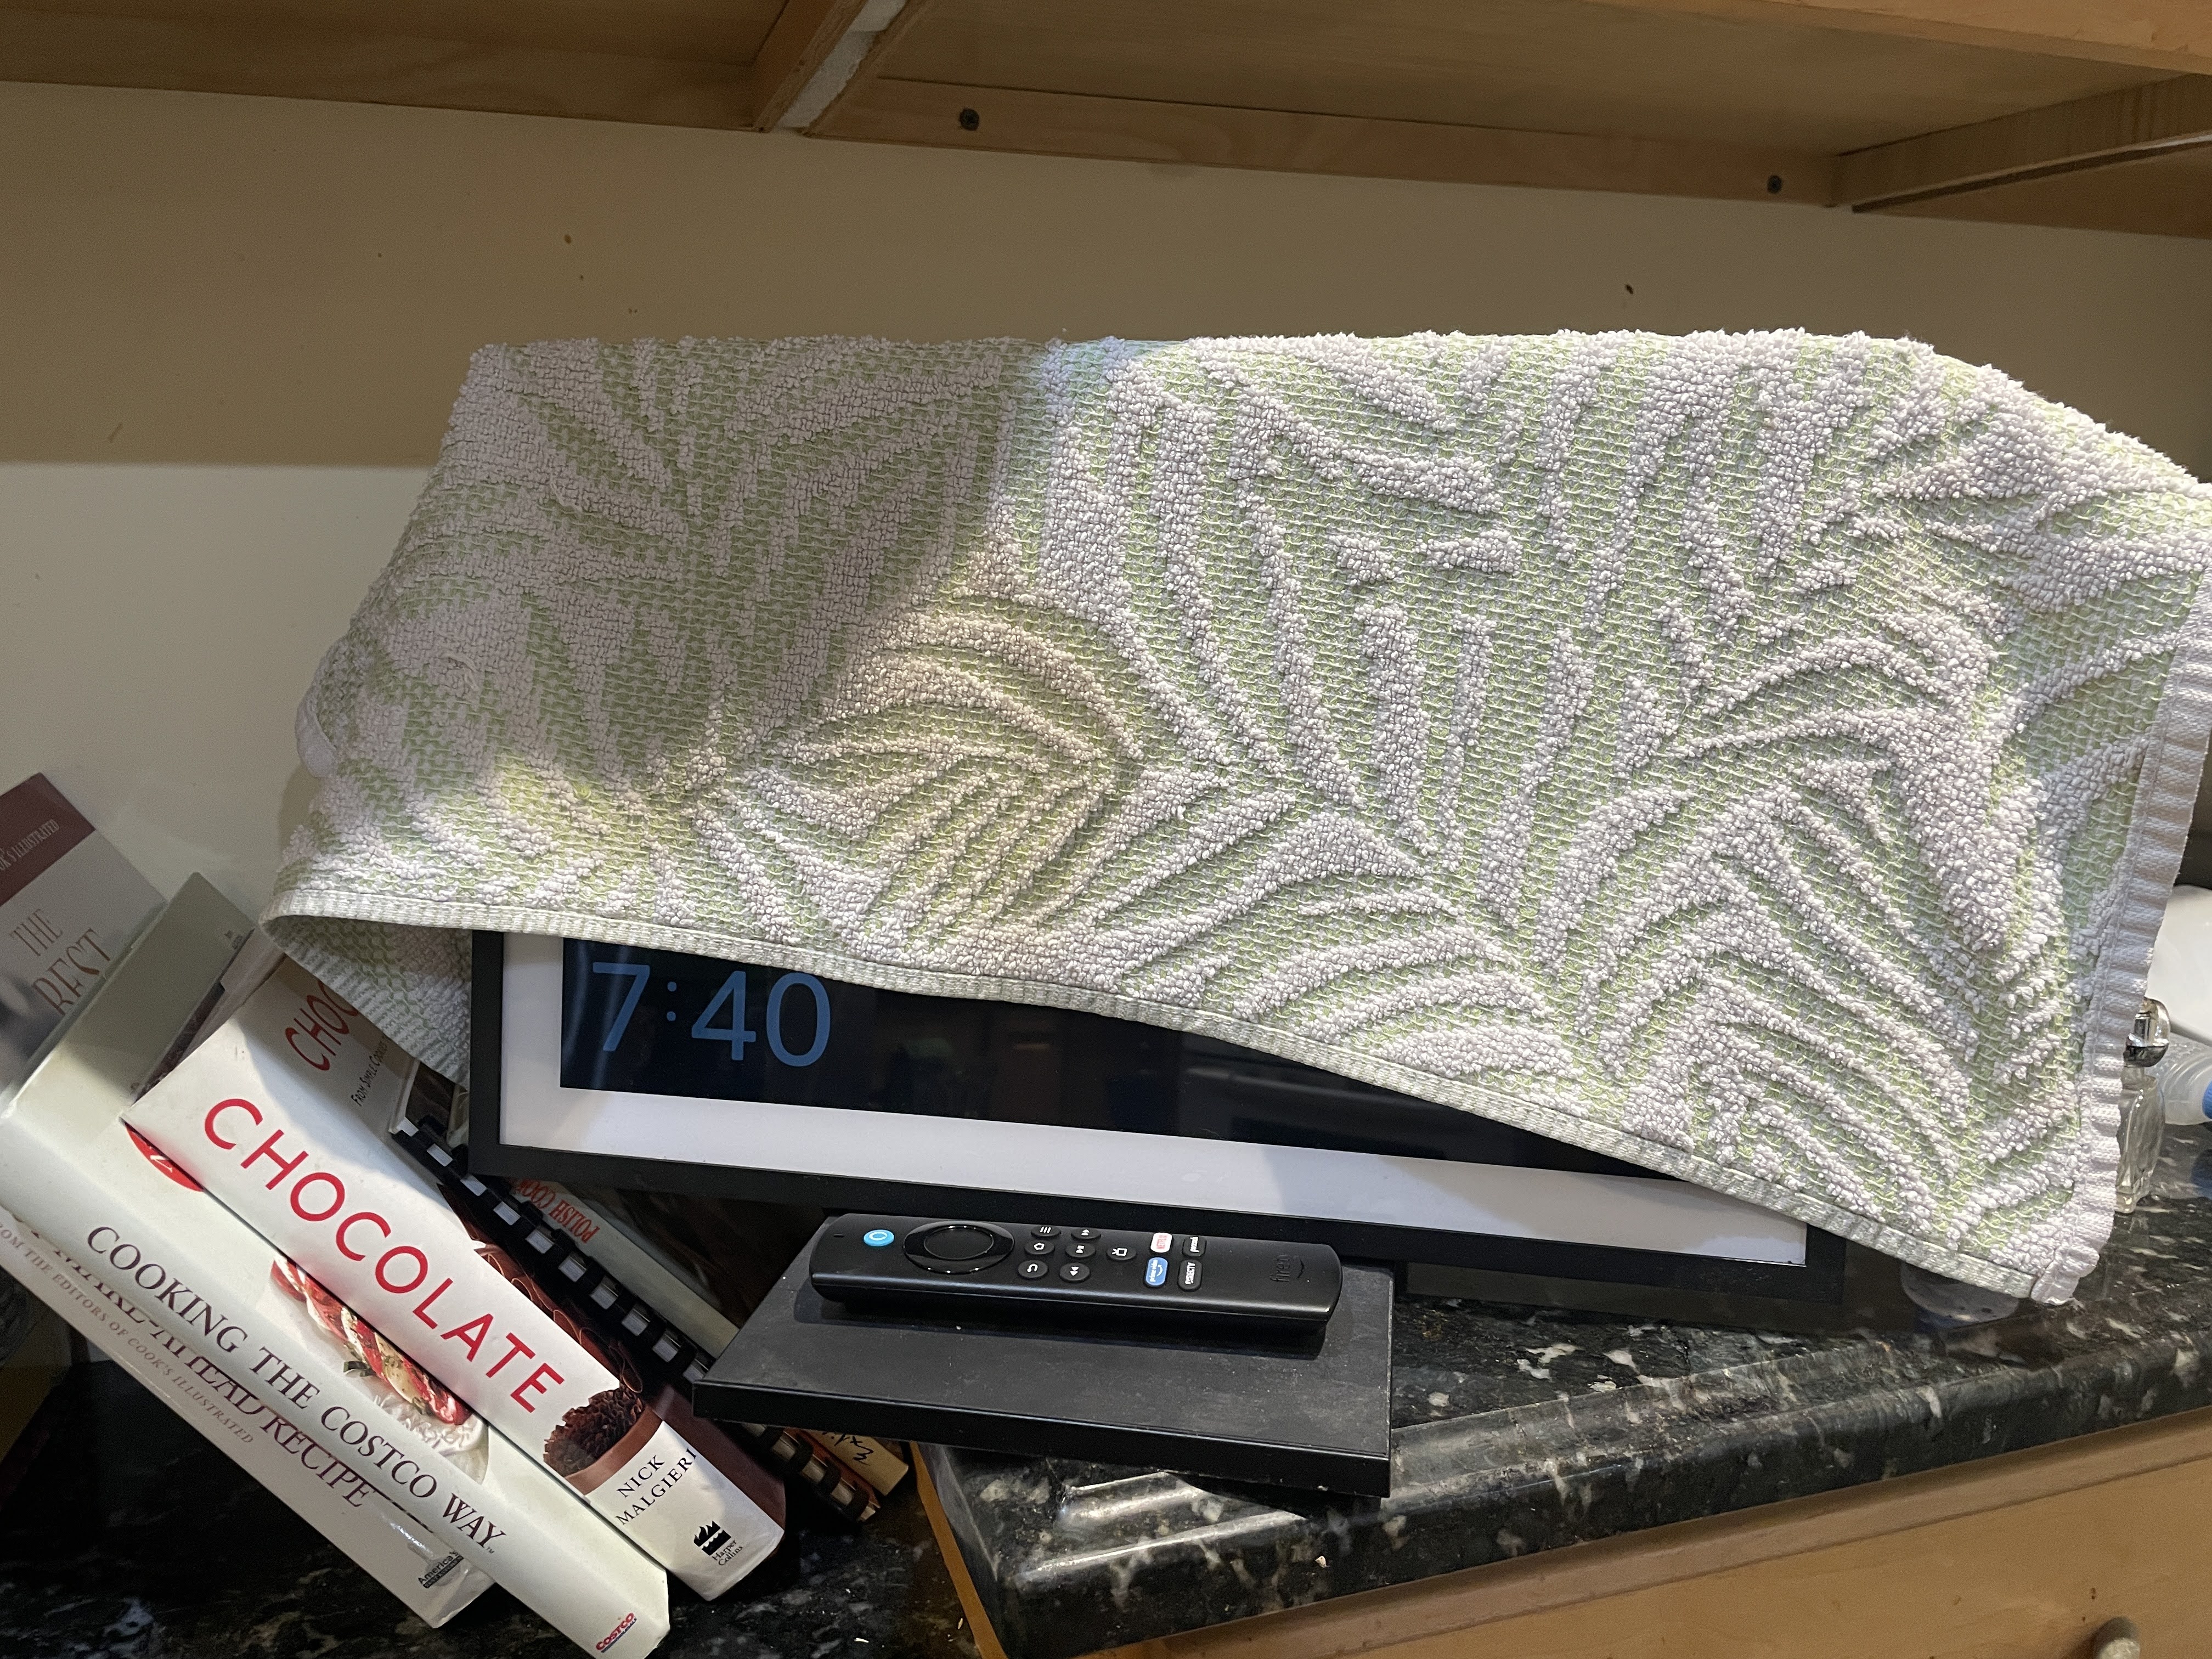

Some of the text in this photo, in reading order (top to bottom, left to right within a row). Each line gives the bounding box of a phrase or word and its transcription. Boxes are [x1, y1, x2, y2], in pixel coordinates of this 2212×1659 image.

[10, 819, 60, 857] ILLUSTRATED
[10, 908, 63, 956] THE
[592, 961, 831, 1067] 7:40
[351, 1085, 369, 1107] FROM
[549, 1199, 600, 1244] POLISH
[205, 1098, 565, 1413] CHOCOLATE
[0, 1223, 26, 1249] OM
[24, 1248, 53, 1273] THE
[53, 1273, 109, 1323] EDITORS
[110, 1321, 129, 1338] OF
[128, 1337, 172, 1376] COOK'S
[172, 1375, 255, 1444] ILLUSTRATED
[88, 1226, 248, 1353] COOKING
[249, 1346, 320, 1409] THE
[320, 1406, 437, 1498] COSTCO
[259, 1414, 377, 1508] RECIPE
[616, 1454, 665, 1498] NICK
[615, 1448, 697, 1525] MALGIERI
[417, 1550, 459, 1585] America's
[712, 1539, 737, 1561] Harper
[718, 1545, 743, 1566] Collins
[596, 1612, 634, 1650] COSTCO
